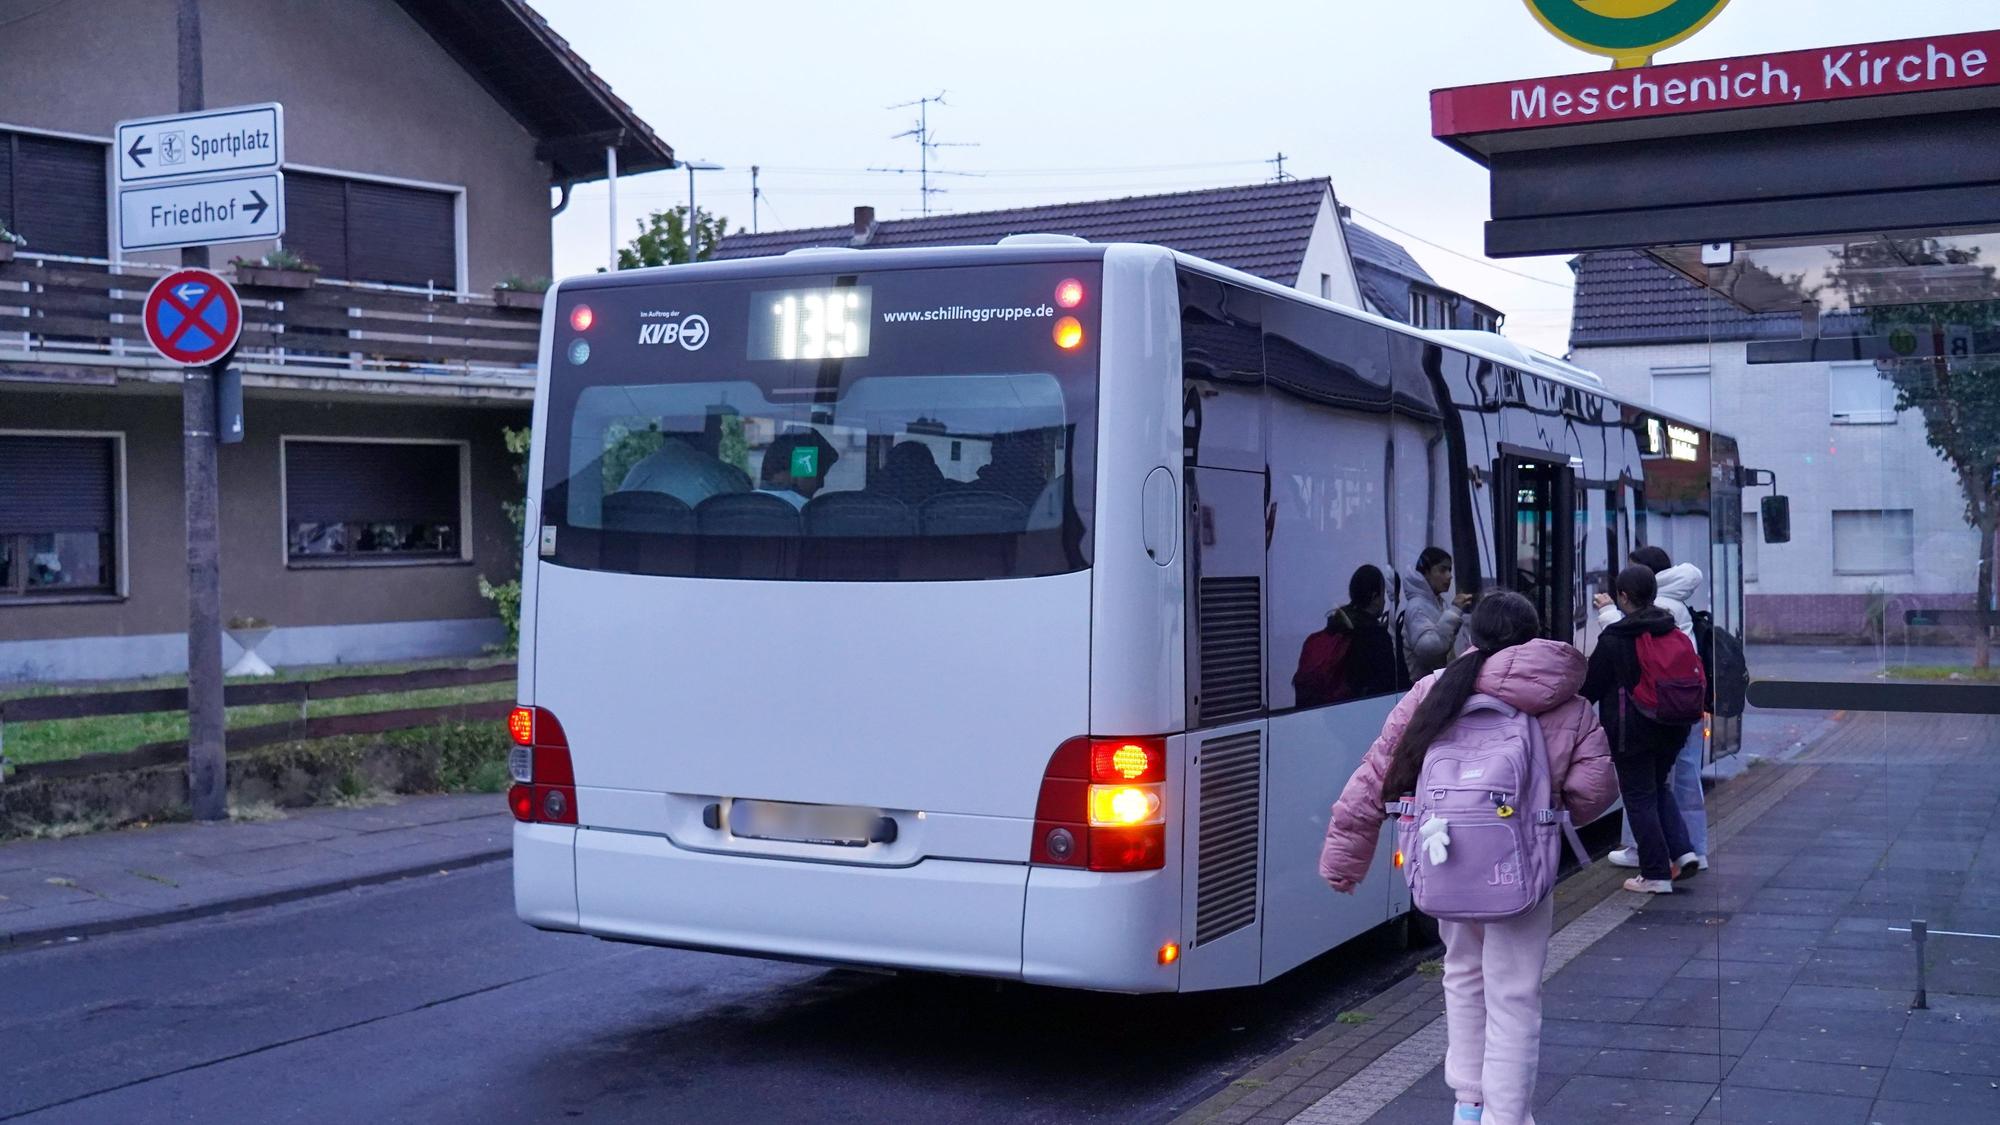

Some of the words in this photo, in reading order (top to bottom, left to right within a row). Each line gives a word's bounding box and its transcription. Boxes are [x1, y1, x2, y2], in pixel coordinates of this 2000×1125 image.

[1509, 61, 1801, 120] Meschenich,
[1822, 44, 1988, 89] Kirche
[191, 129, 270, 161] Sportplatz
[151, 198, 236, 228] Friedhof
[648, 310, 670, 319] Auftrag
[670, 309, 680, 317] der
[773, 292, 859, 359] 135
[883, 303, 1054, 323] www.schillinggruppe.de
[638, 323, 679, 345] KVB
